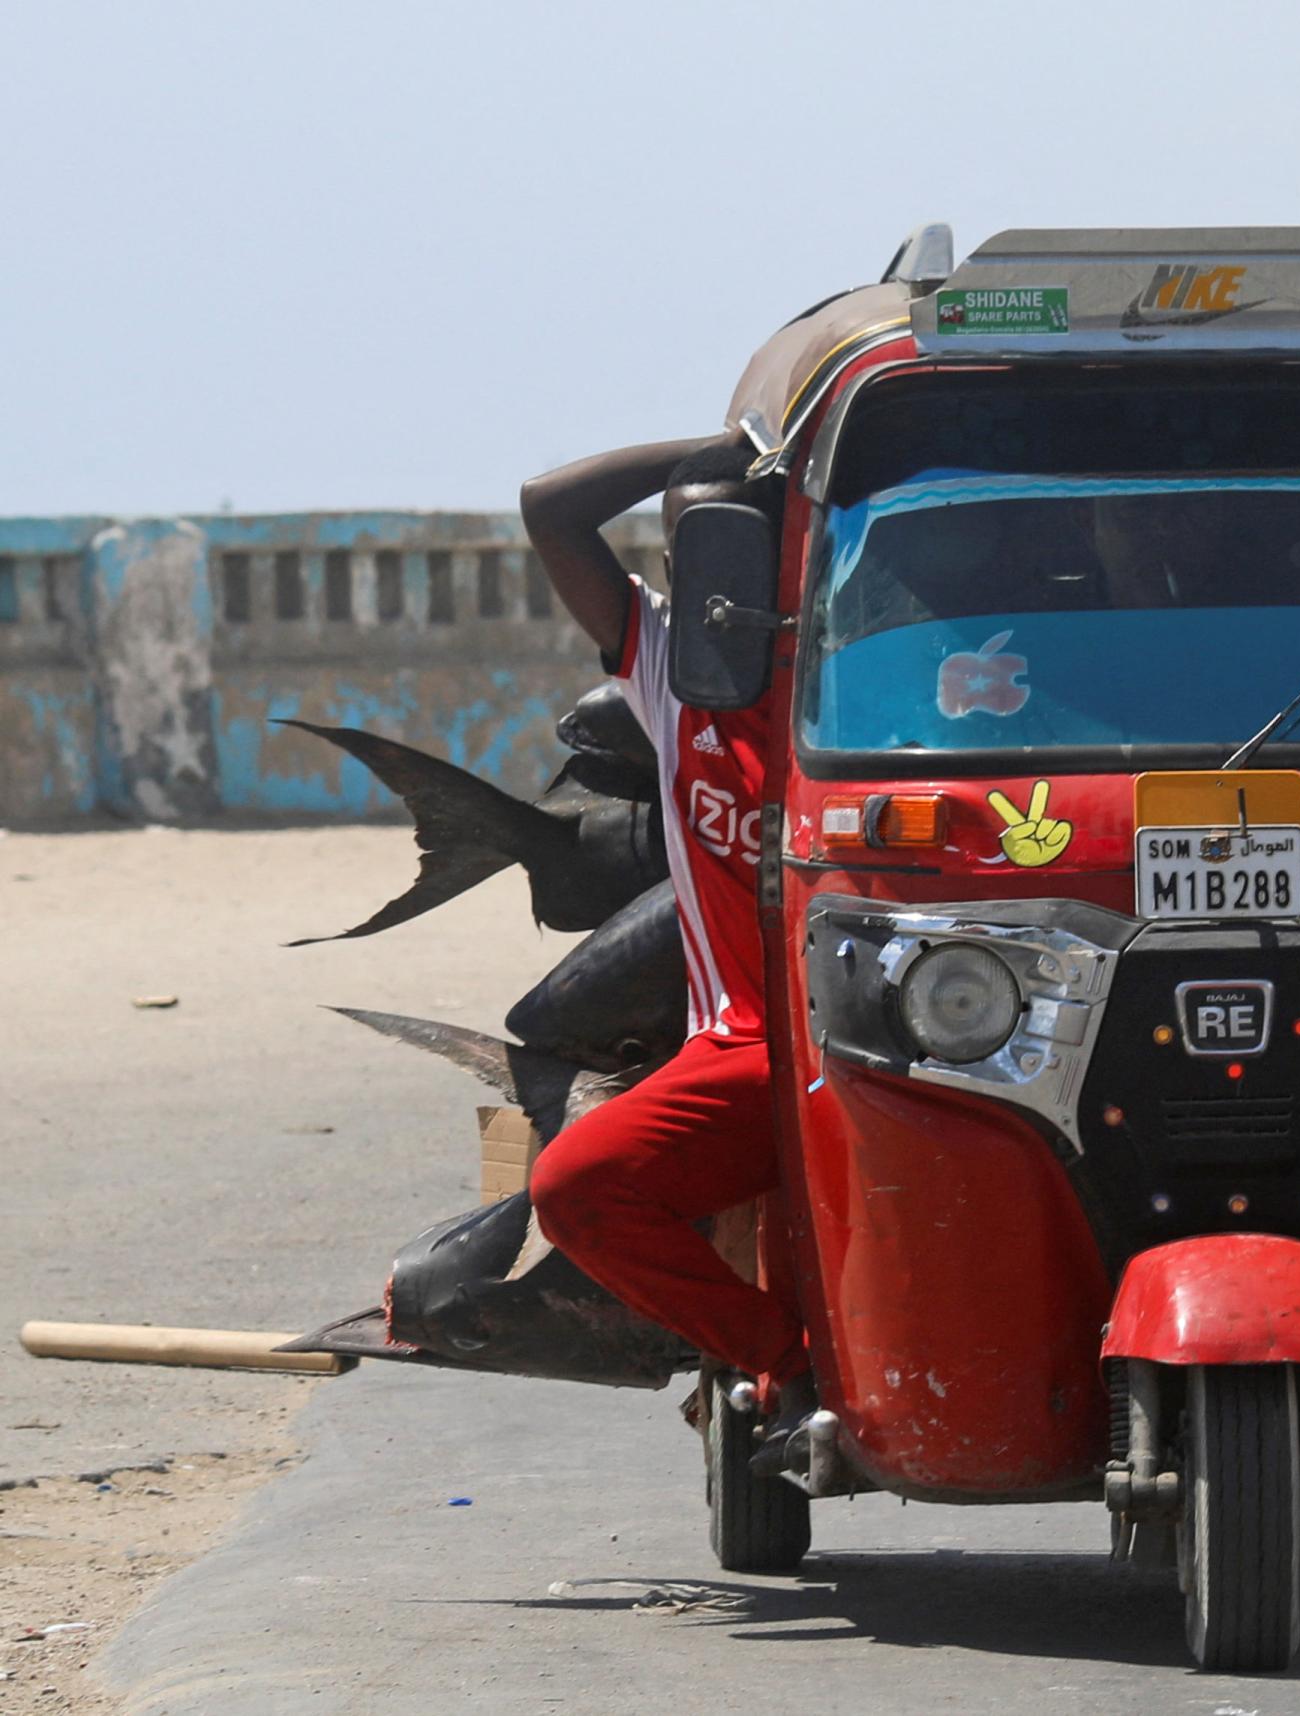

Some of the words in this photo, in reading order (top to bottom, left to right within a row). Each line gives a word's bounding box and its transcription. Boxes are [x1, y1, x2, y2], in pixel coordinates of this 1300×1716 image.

[1141, 264, 1248, 311] NIKE
[964, 291, 1044, 308] SHIDANE
[969, 311, 1003, 322] SPARE
[1006, 311, 1042, 321] PARTS
[1149, 839, 1191, 859] SOM
[1153, 870, 1291, 911] M1B288
[1205, 993, 1246, 1003] BAJAJ
[1197, 1005, 1256, 1038] RE
